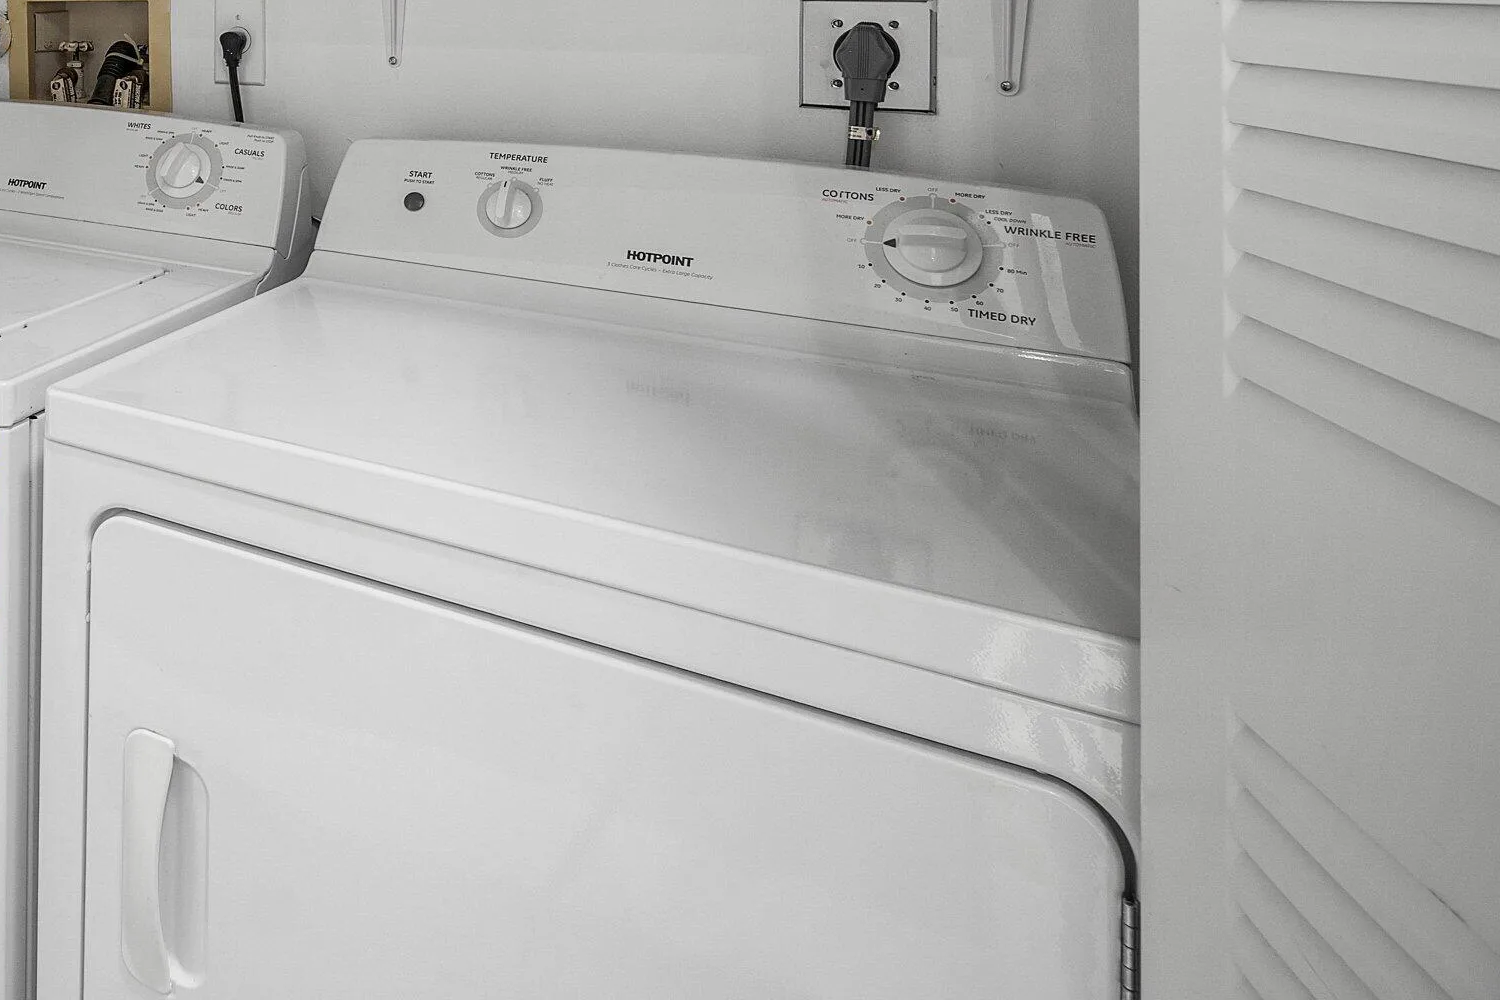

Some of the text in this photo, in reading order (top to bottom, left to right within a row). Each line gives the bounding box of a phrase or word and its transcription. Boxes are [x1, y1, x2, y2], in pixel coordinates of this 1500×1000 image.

[234, 148, 265, 158] CASUALS
[490, 152, 548, 164] TEMPERATURE
[409, 170, 432, 178] START
[8, 178, 47, 190] HOTPOINT
[215, 202, 243, 212] COLORS
[1004, 226, 1096, 244] WRINKLE FREE
[626, 250, 694, 267] HOTPOINT
[968, 308, 1036, 326] TIMED DRY
